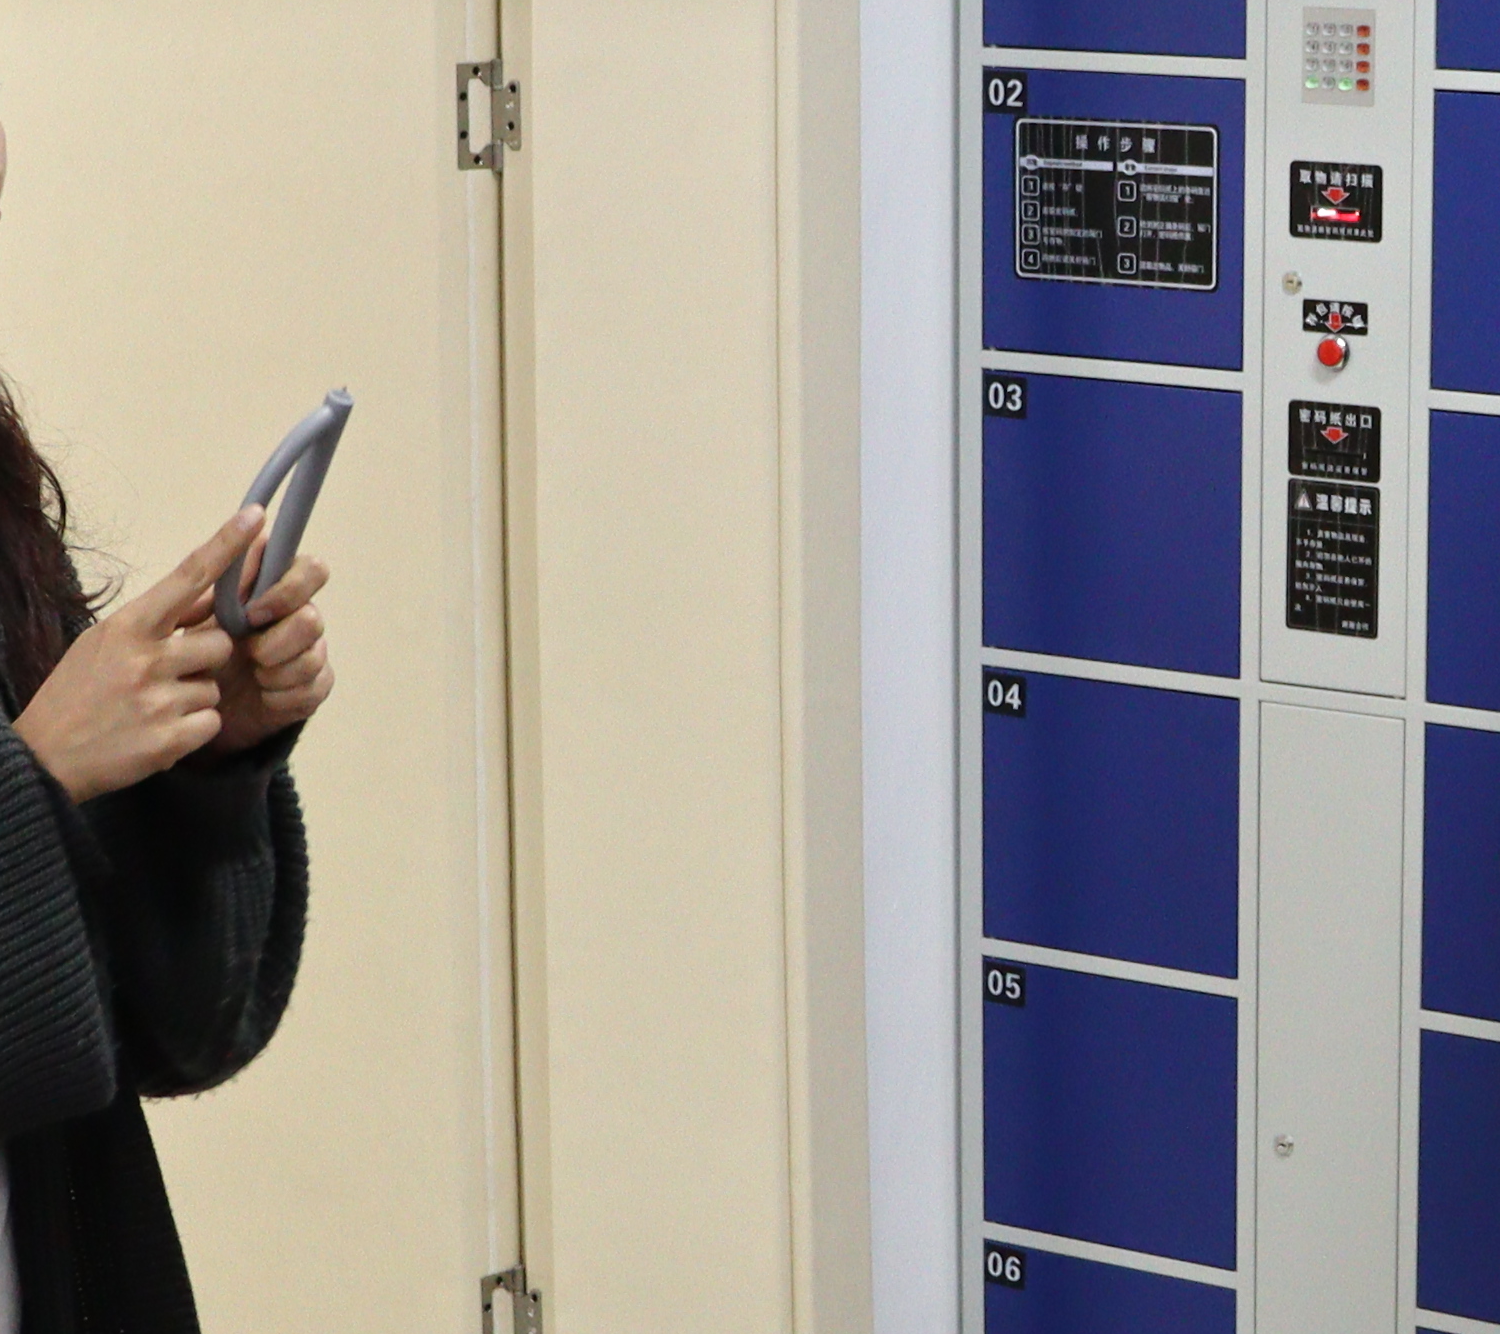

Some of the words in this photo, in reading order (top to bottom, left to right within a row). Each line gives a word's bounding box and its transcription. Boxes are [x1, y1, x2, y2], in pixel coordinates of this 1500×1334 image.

[988, 78, 1023, 107] 02
[988, 382, 1022, 411] 03
[987, 679, 1022, 710] 04
[987, 969, 1021, 999] 05
[987, 1251, 1021, 1282] 06
